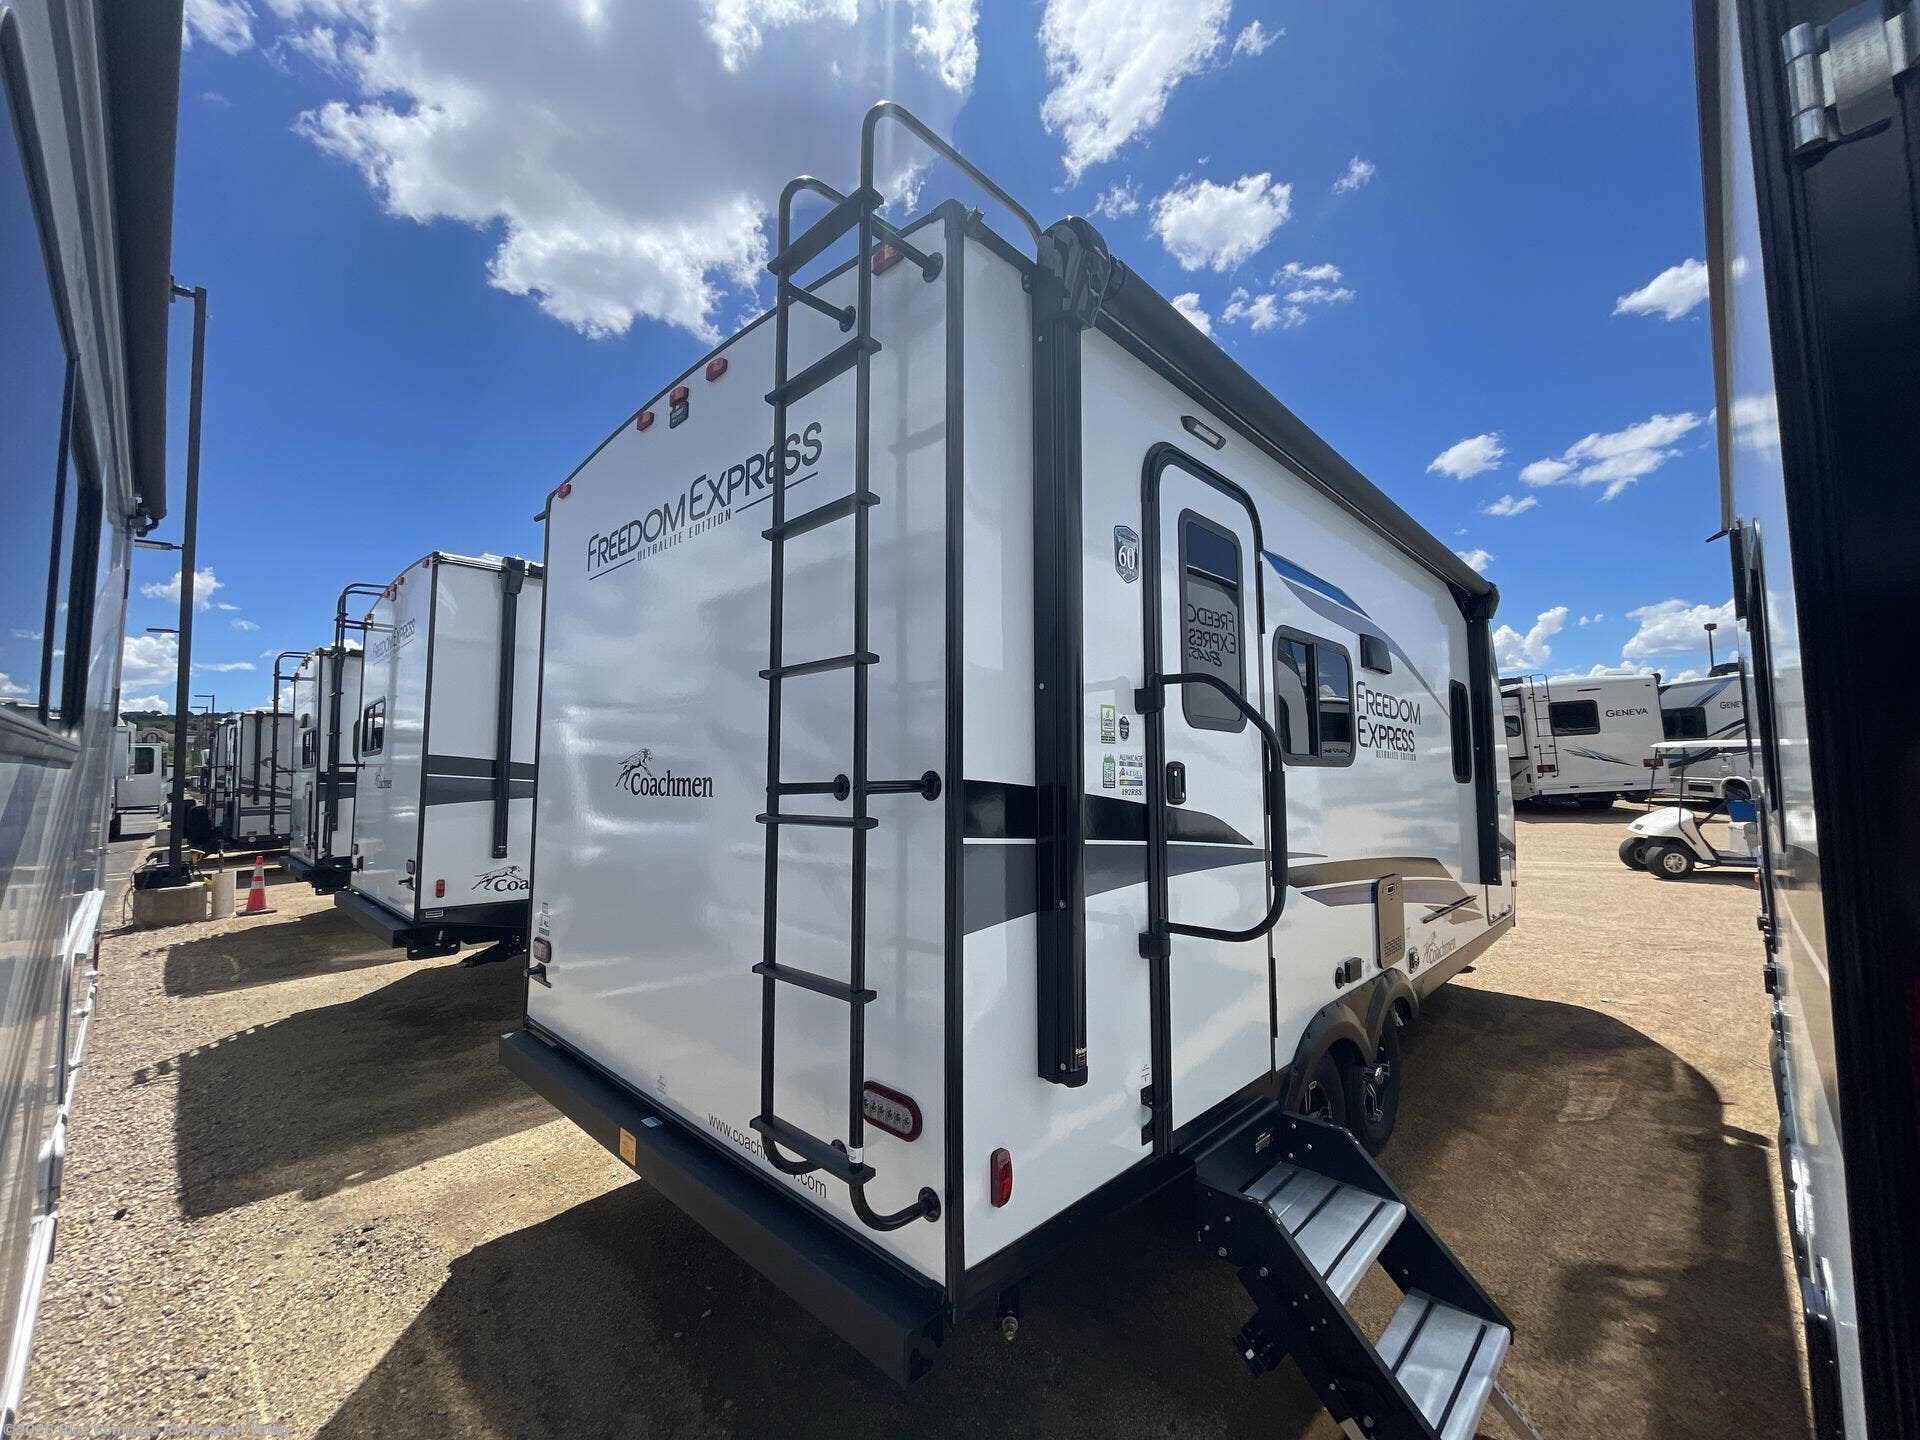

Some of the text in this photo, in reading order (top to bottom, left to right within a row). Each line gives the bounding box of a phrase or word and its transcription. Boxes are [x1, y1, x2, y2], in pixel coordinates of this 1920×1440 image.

[637, 508, 732, 562] ULTRALITE EDITION
[1356, 680, 1421, 725] FREEDOM
[1605, 707, 1649, 718] GENEVA
[1357, 715, 1415, 753] EXPRESS
[630, 769, 714, 798] Coachmen
[708, 1113, 827, 1198] www.coach.com
